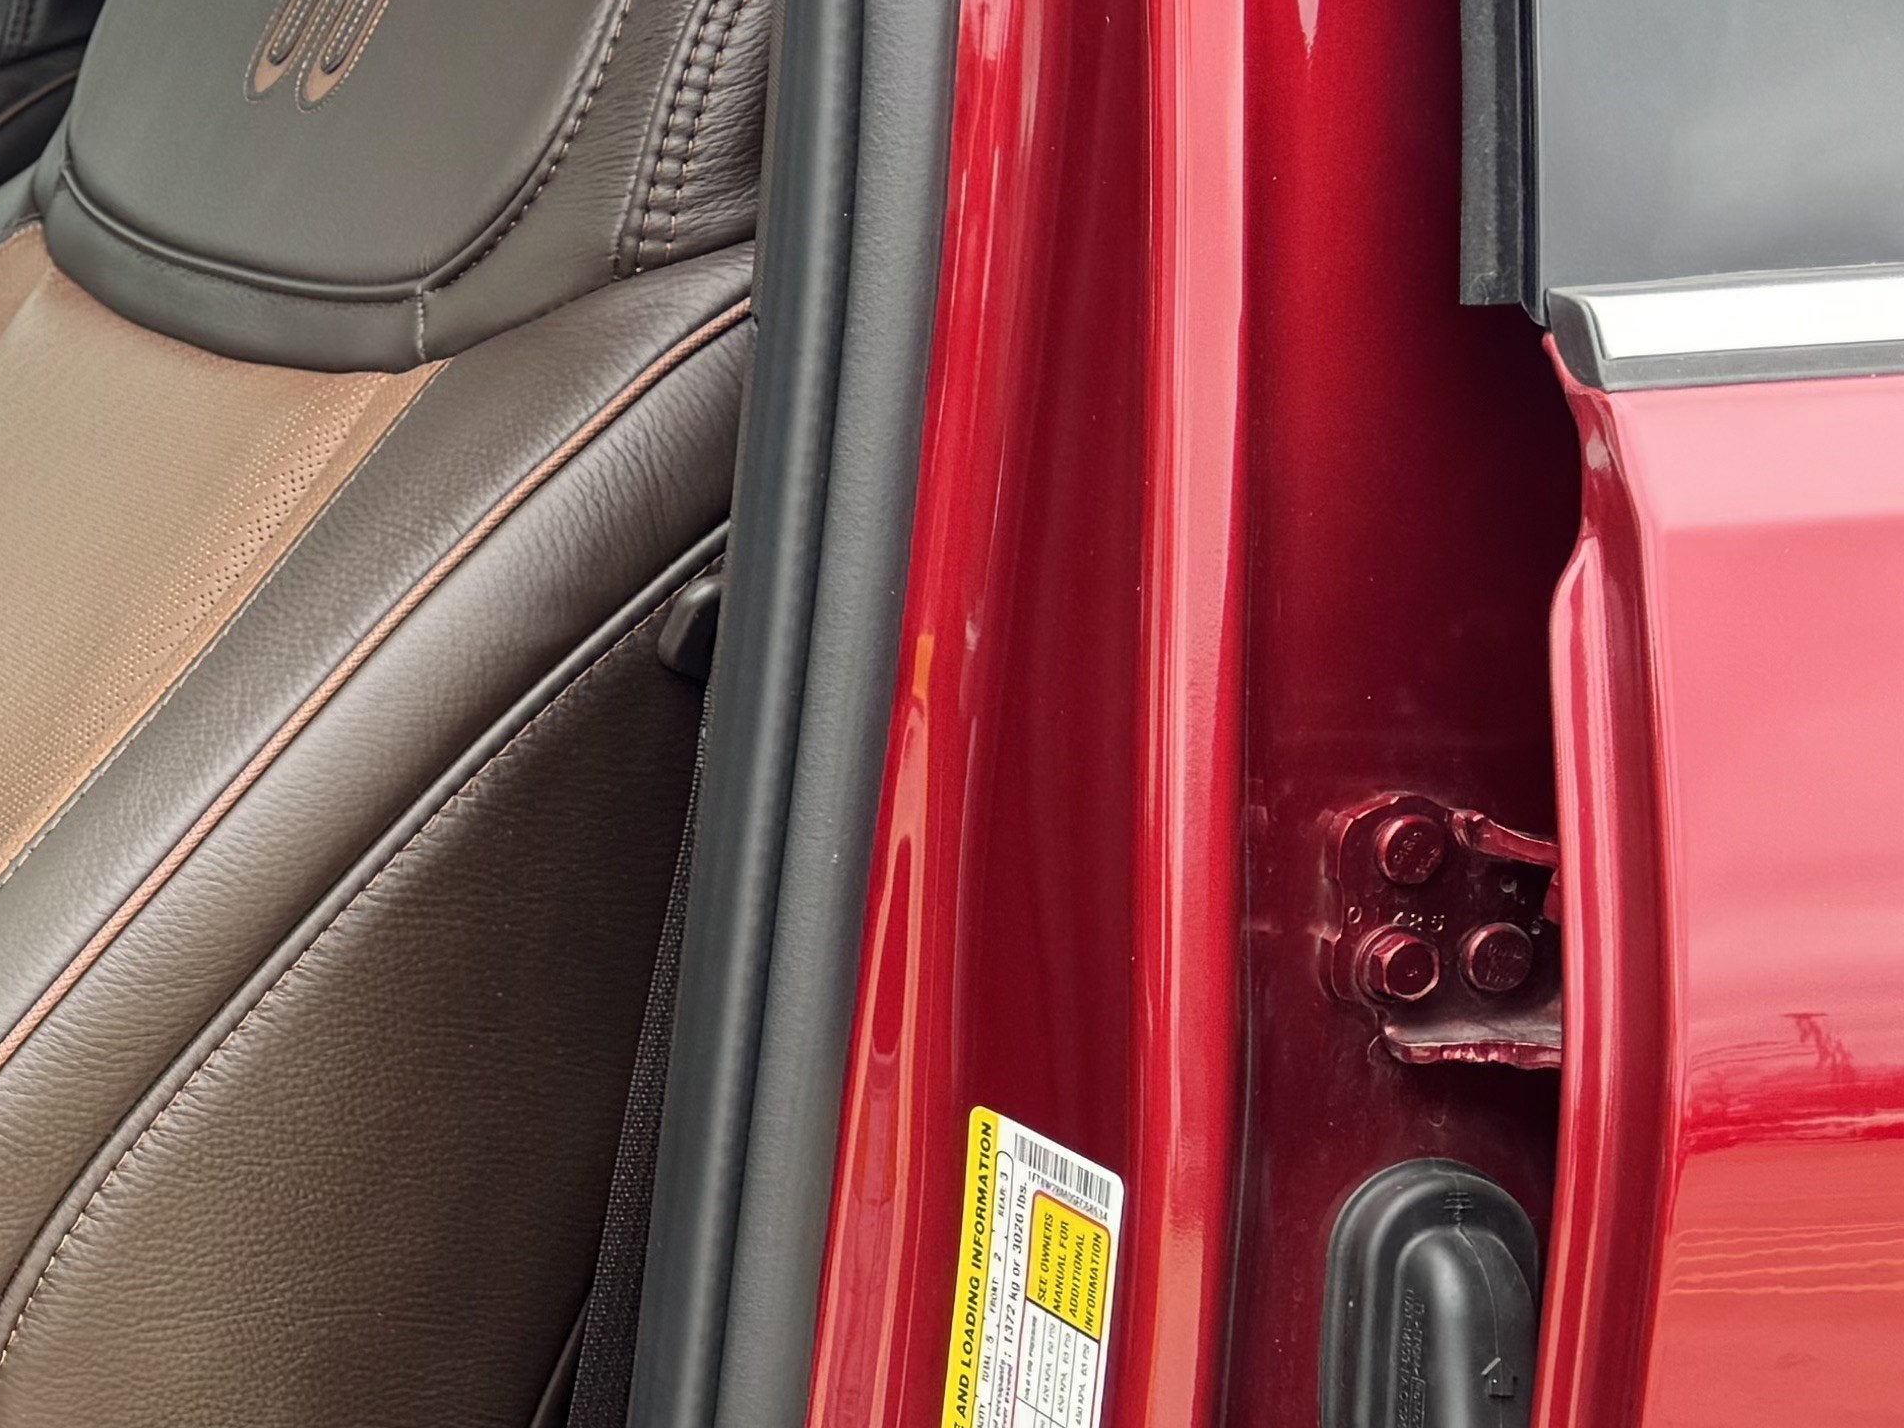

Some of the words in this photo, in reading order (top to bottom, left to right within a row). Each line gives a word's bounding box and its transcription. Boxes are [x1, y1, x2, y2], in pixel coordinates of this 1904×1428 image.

[971, 1122, 990, 1268] INFORMATION
[1016, 1182, 1026, 1209] lbs.
[1040, 1212, 1053, 1272] OWNERS
[1059, 1220, 1068, 1249] FOR
[1012, 1259, 1020, 1276] or
[1037, 1276, 1047, 1302] SEE
[1053, 1254, 1066, 1312] MANUAL
[1069, 1234, 1084, 1317] ADDITIONAL
[1084, 1232, 1101, 1330] INFORMATION
[1008, 1281, 1020, 1300] kg
[961, 1276, 979, 1367] LOADING
[1003, 1304, 1015, 1343] 1372
[956, 1374, 969, 1418] AND
